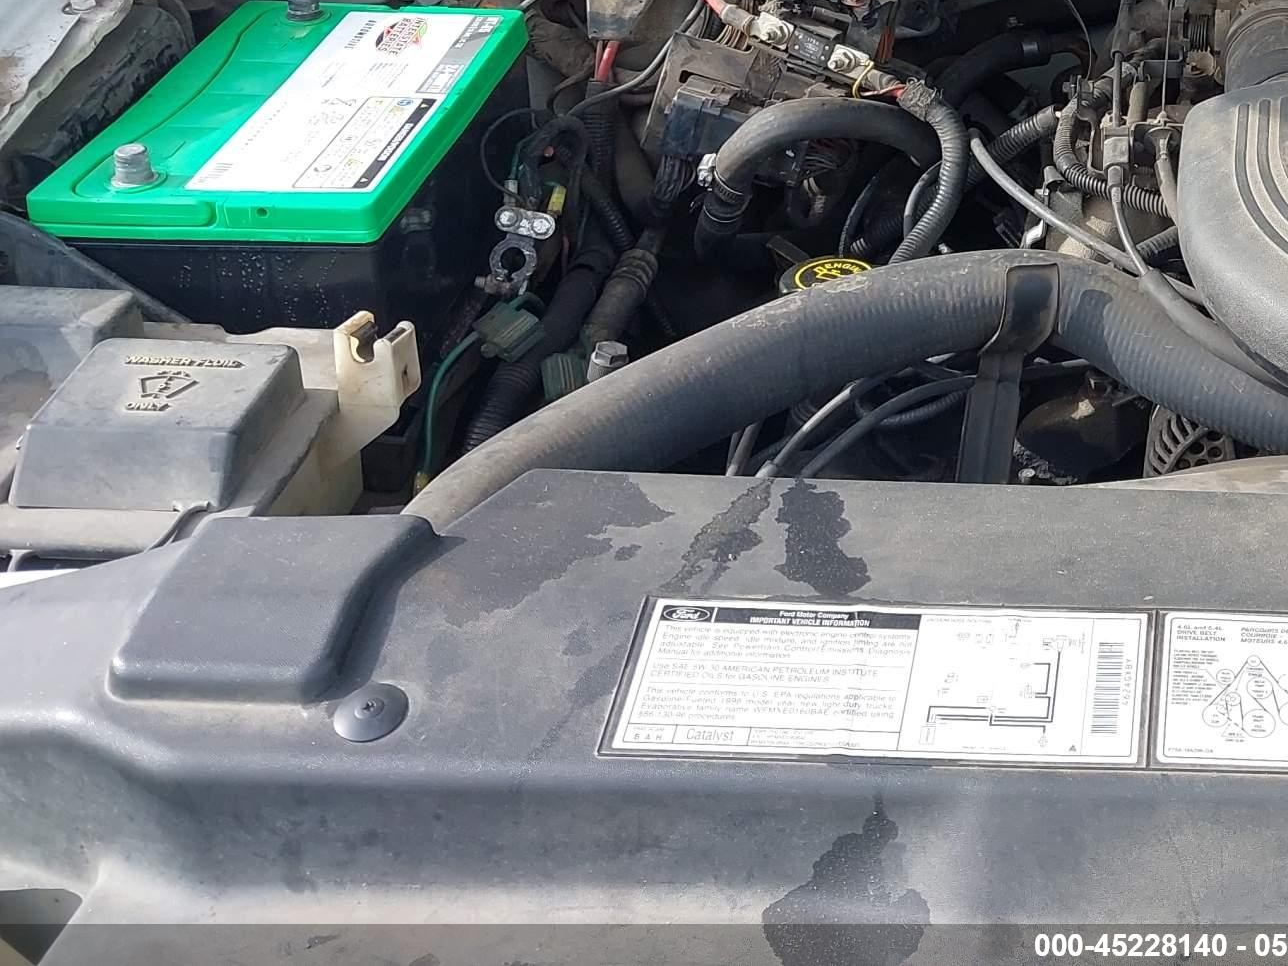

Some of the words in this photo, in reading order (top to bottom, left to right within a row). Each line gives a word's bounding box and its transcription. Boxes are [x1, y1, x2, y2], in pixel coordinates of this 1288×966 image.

[378, 18, 412, 52] BATTERIES
[389, 17, 426, 55] INTERSTATE
[126, 355, 191, 367] WASHER
[125, 401, 171, 412] ONLY
[672, 609, 700, 619] Ford
[686, 728, 734, 742] Catalyst
